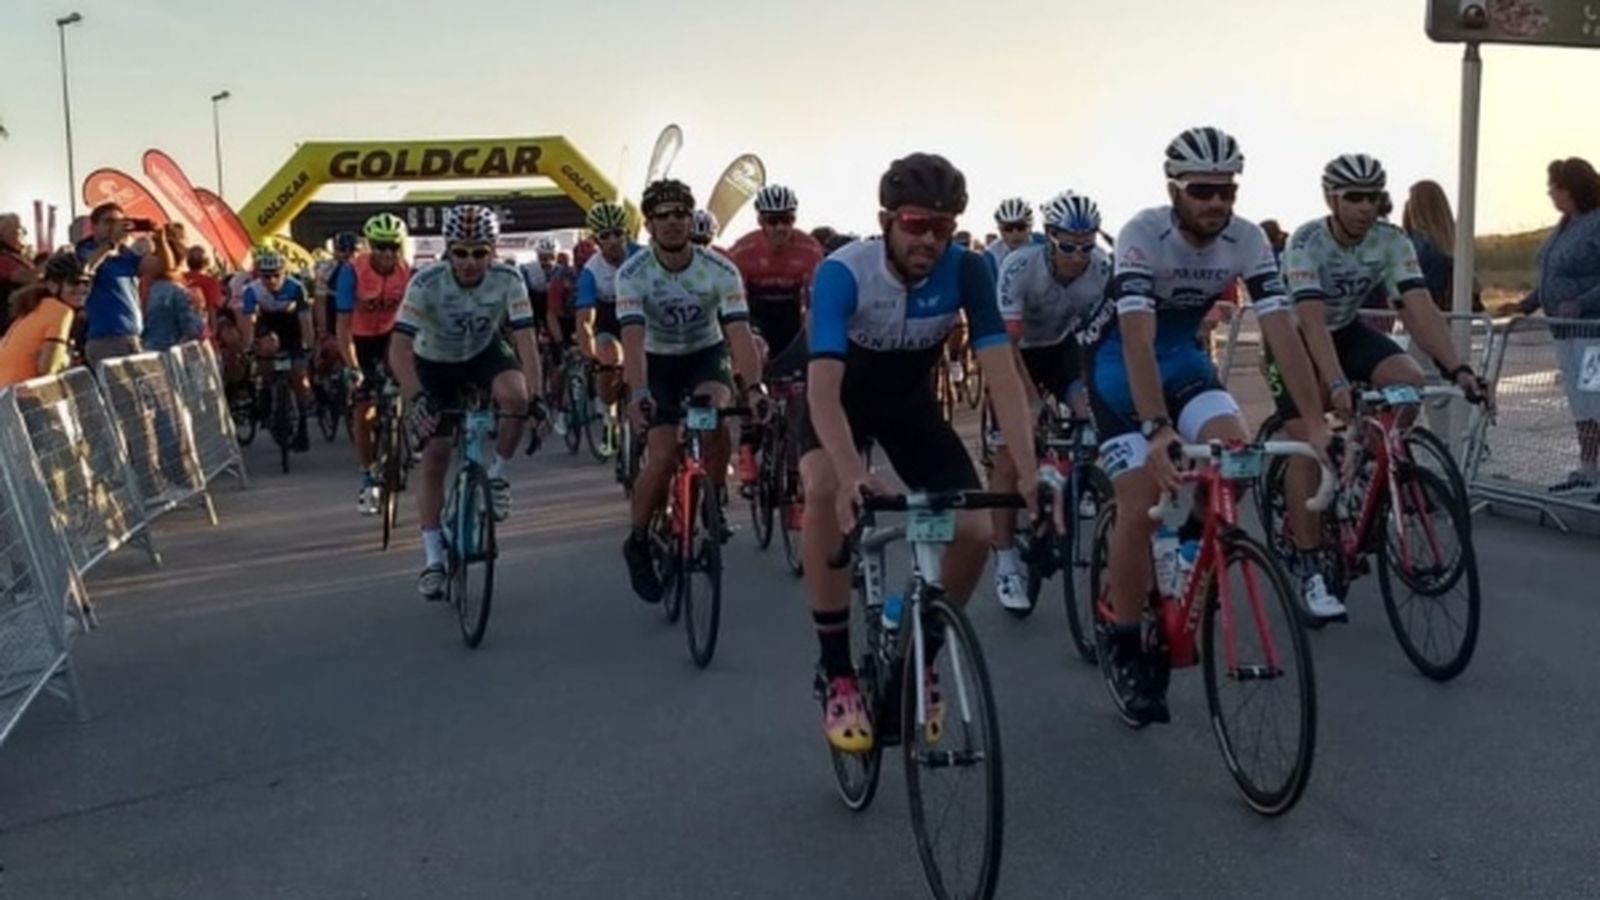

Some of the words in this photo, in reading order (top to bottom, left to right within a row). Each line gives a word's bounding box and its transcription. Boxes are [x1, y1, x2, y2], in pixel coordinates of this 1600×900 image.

[329, 146, 543, 179] GOLDCAR
[257, 170, 310, 227] GOLDCAR
[1328, 277, 1371, 299] 312
[447, 316, 491, 336] 312
[660, 304, 704, 328] 312
